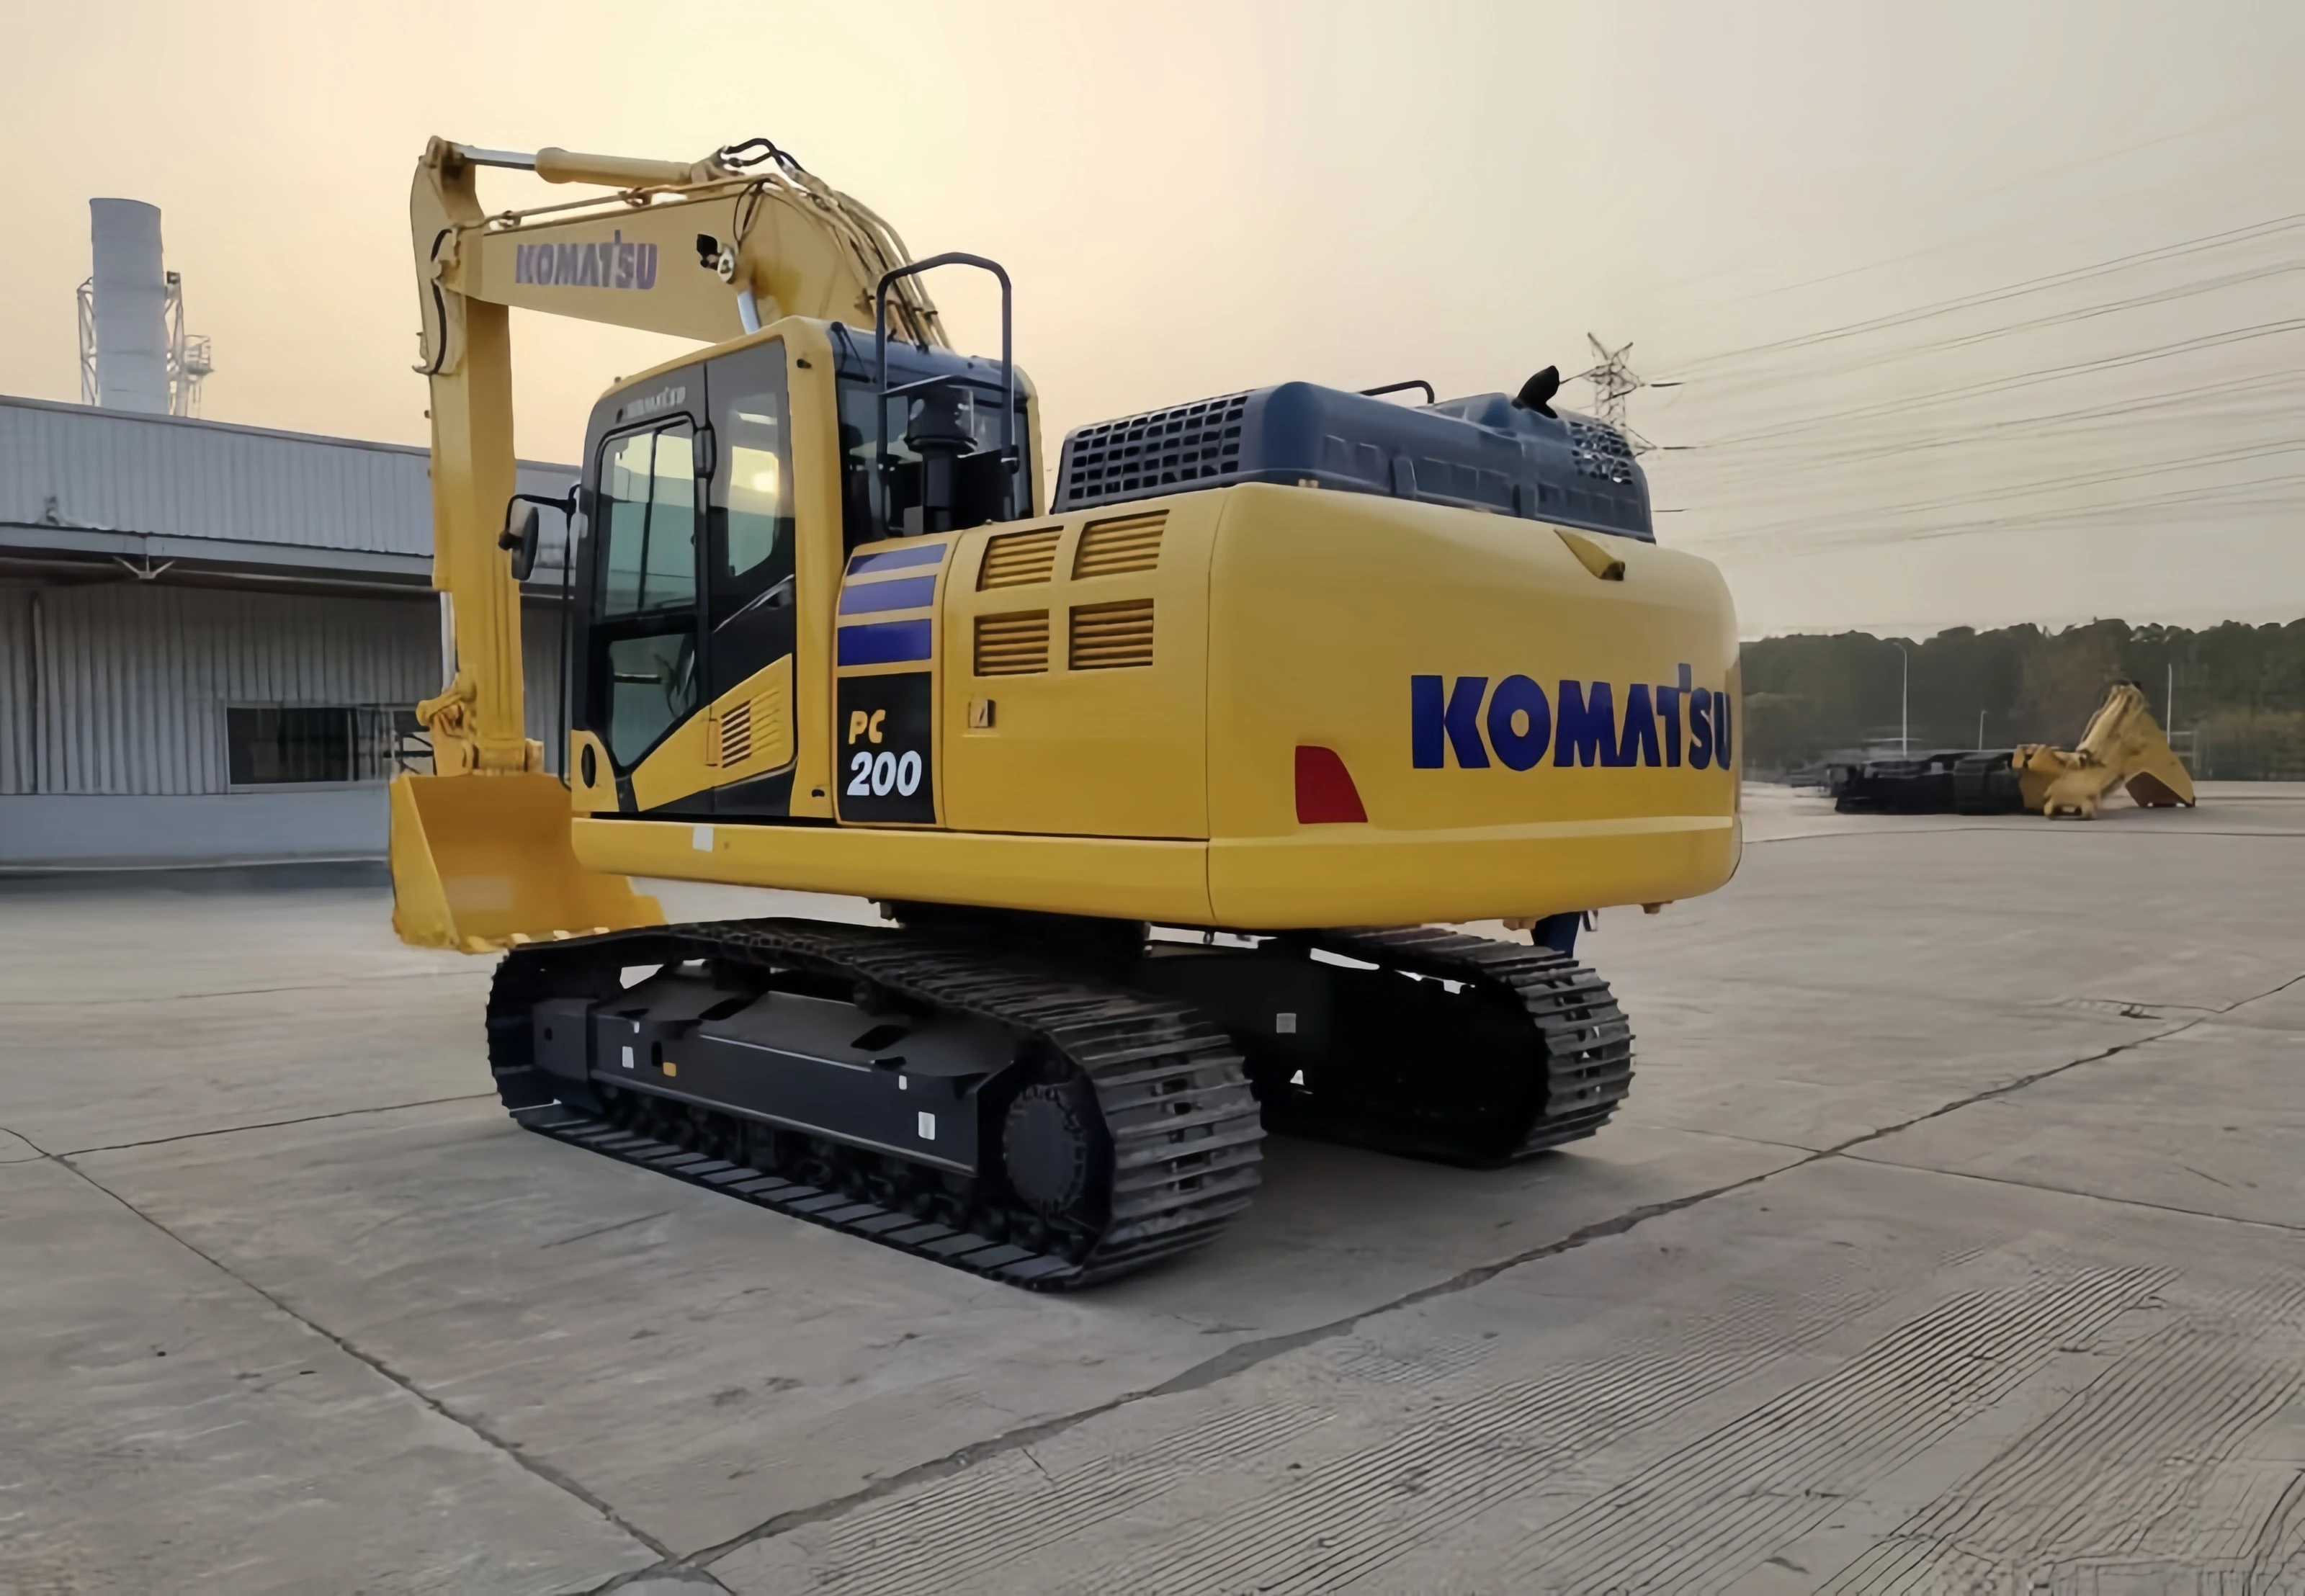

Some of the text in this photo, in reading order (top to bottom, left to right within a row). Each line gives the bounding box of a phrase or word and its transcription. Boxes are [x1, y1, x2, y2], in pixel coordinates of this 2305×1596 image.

[849, 709, 886, 745] PC
[1411, 663, 1732, 771] KOMATSU
[846, 750, 922, 797] 200
